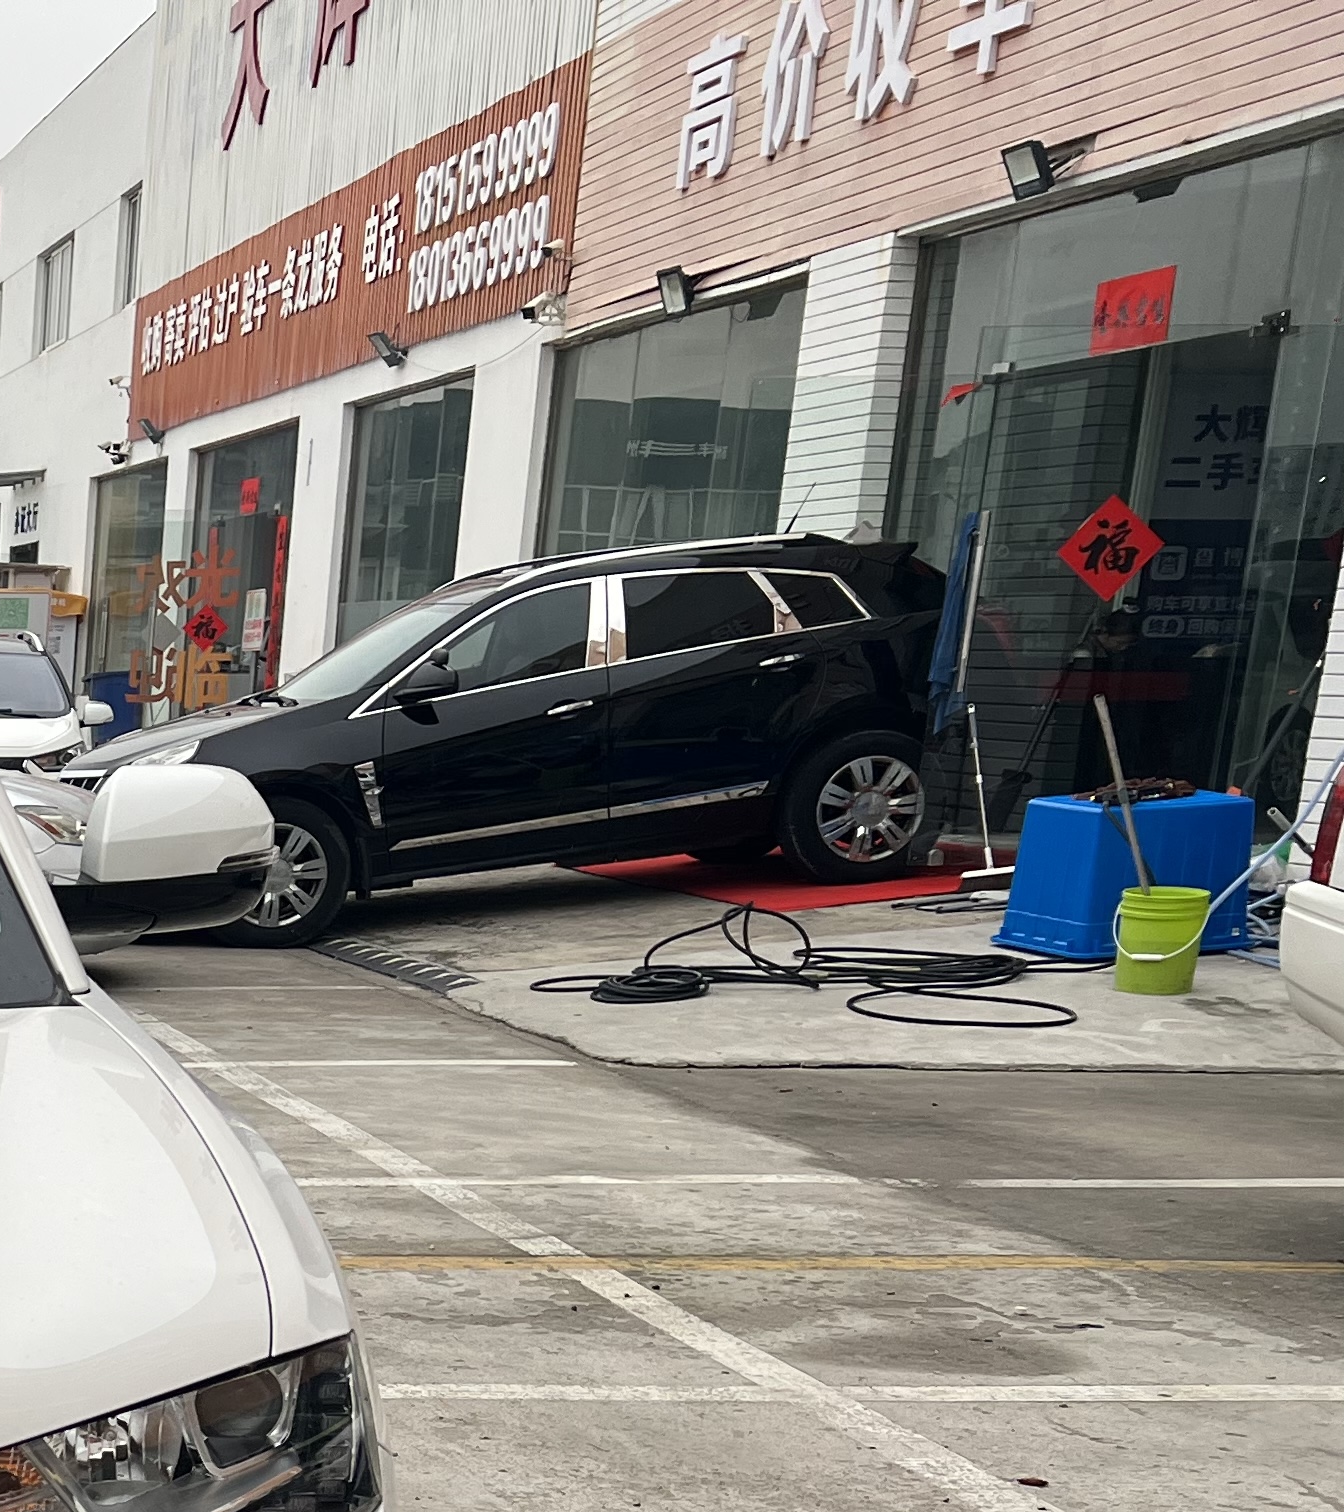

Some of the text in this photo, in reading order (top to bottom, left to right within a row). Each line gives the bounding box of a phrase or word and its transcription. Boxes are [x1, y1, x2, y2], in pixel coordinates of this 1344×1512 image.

[415, 102, 560, 236] 18151599999
[407, 194, 551, 313] 18013669999
[1078, 519, 1141, 575] 福
[192, 613, 217, 640] 福
